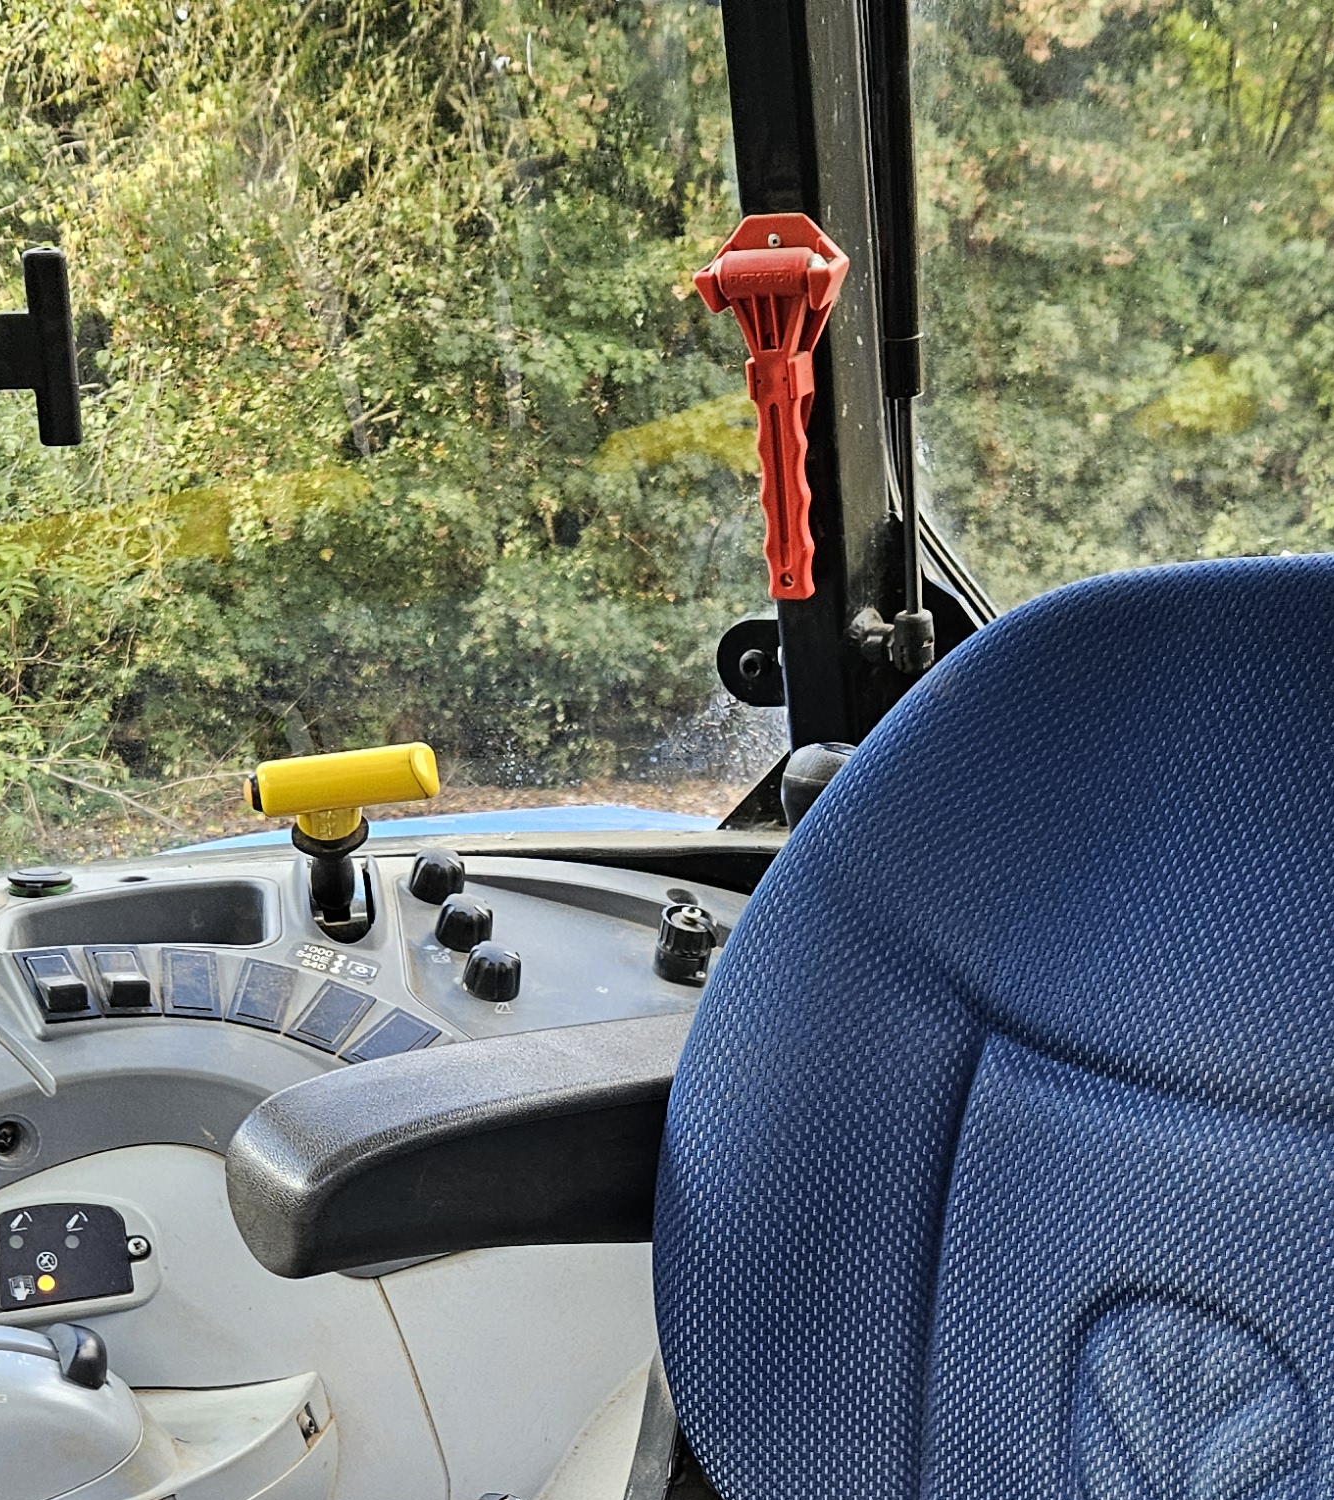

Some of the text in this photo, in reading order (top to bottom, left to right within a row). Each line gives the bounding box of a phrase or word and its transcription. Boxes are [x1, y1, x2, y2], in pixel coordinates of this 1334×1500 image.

[295, 950, 331, 965] 540E
[303, 944, 335, 958] 1000
[301, 959, 327, 971] 540
